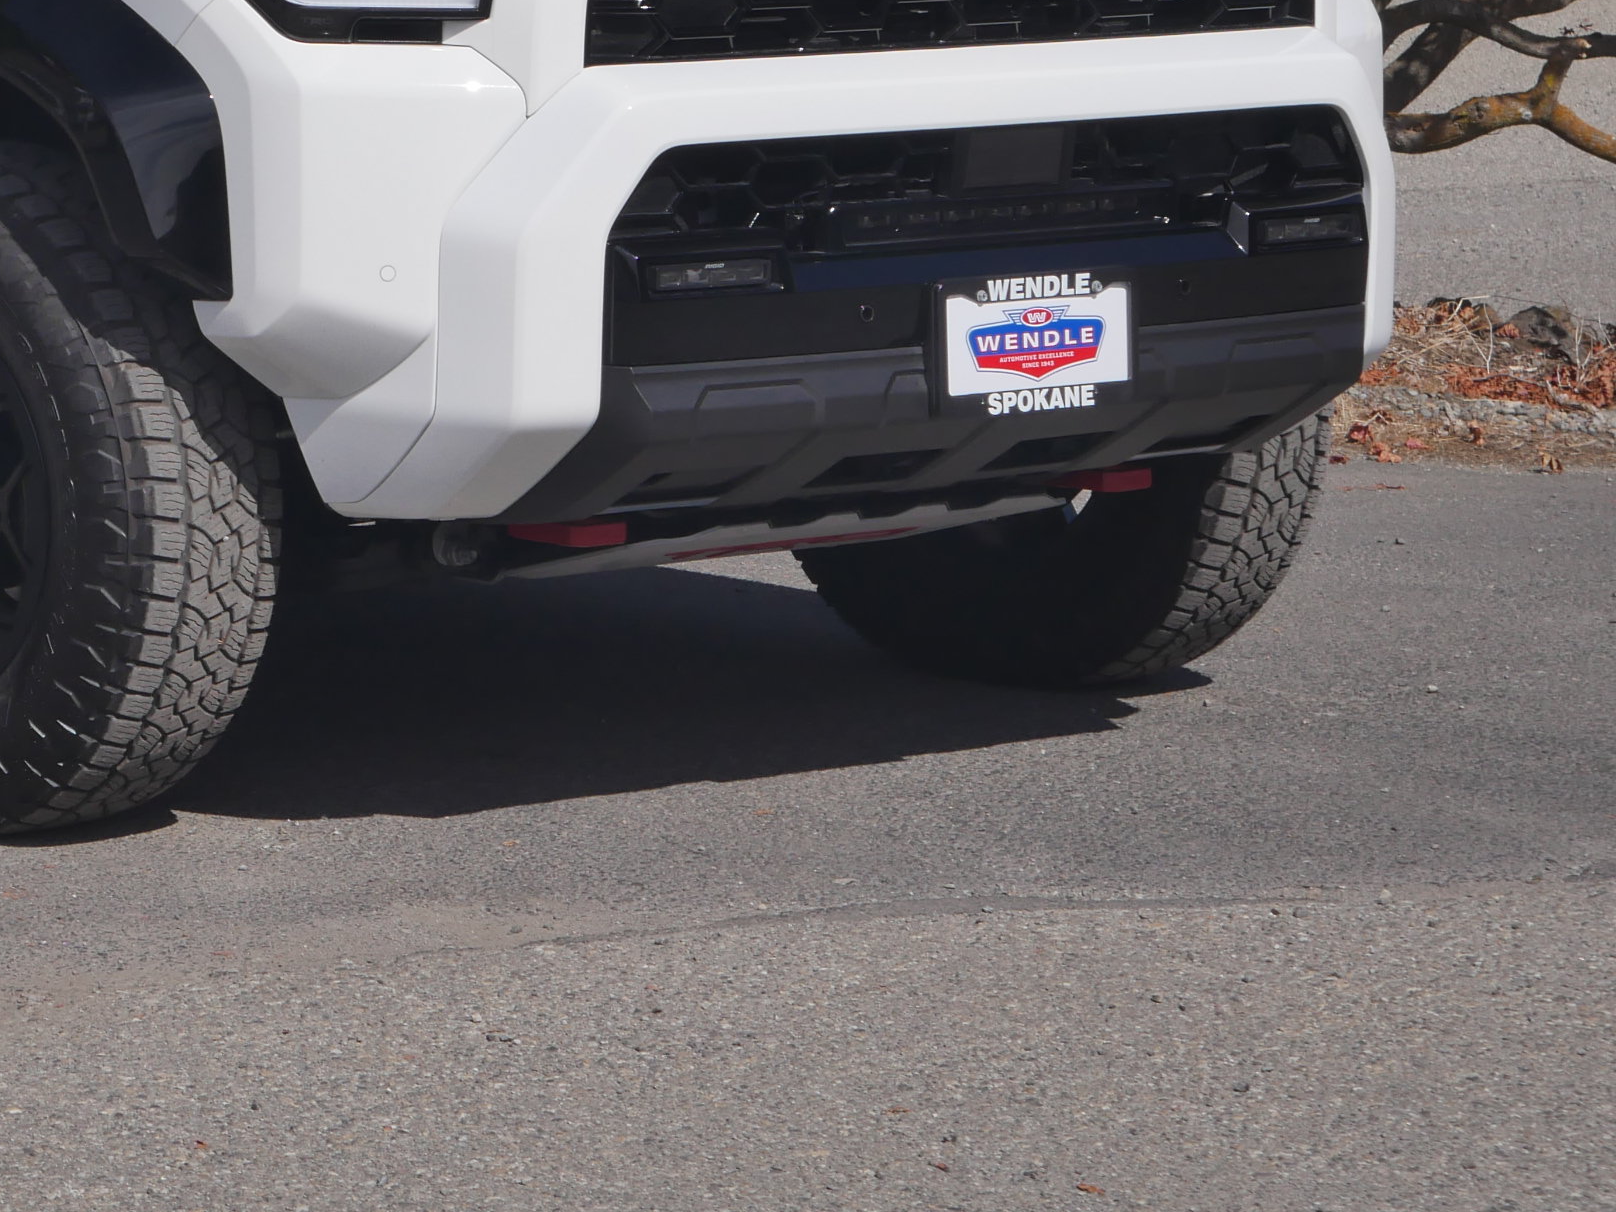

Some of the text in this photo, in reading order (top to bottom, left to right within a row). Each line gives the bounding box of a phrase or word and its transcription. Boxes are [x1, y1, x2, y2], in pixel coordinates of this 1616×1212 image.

[987, 273, 1091, 302] WENDLE
[976, 327, 1094, 353] WENDLE
[1000, 351, 1075, 363] AUTOMOTIVE EXCELLENCE
[988, 384, 1095, 416] SPOKANE
